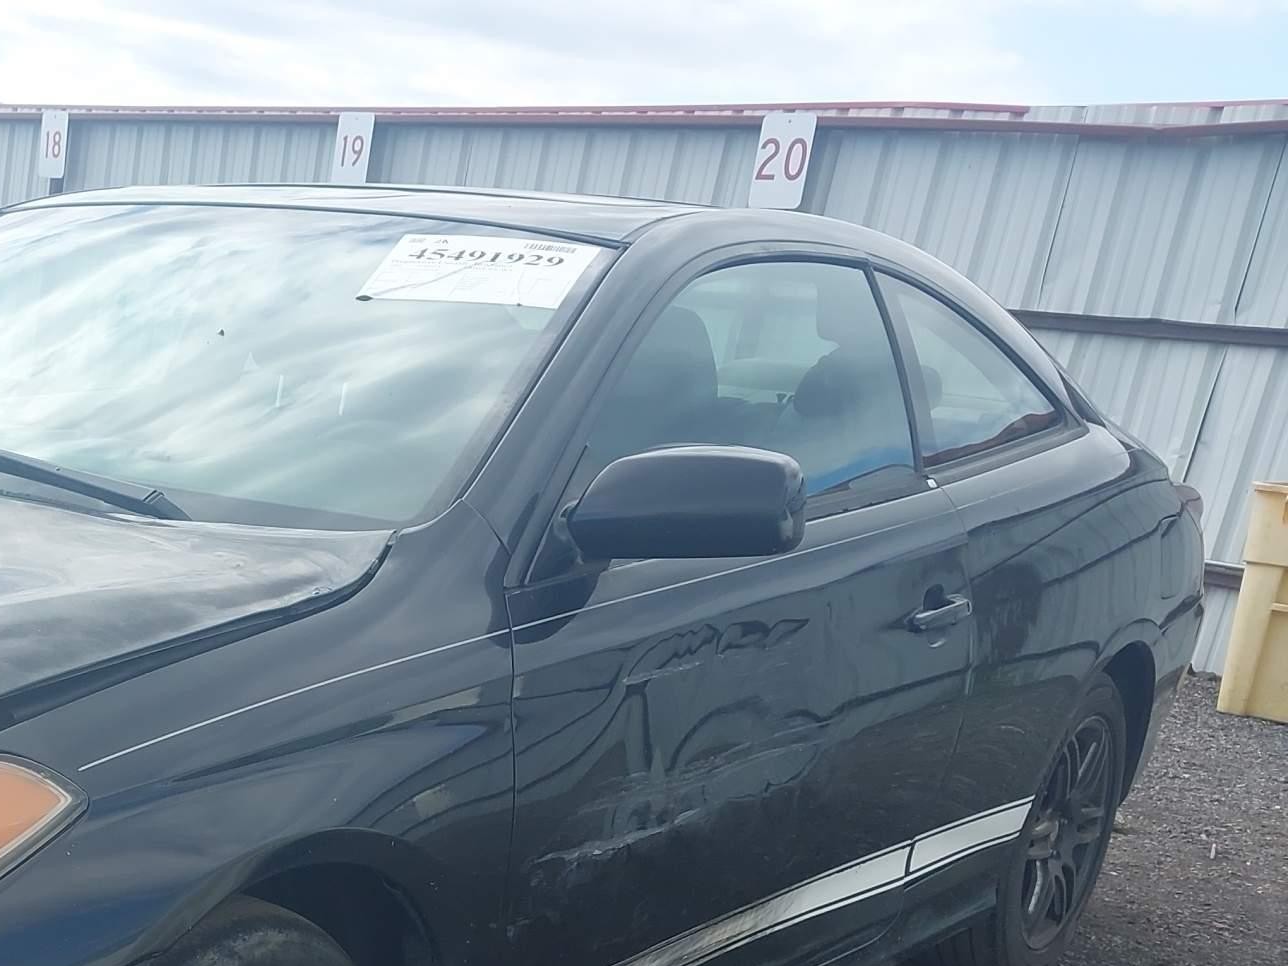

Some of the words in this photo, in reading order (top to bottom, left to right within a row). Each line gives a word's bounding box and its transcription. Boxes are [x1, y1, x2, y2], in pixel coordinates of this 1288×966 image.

[45, 131, 62, 159] 18
[341, 135, 365, 167] 19
[755, 137, 809, 182] 20
[408, 248, 565, 267] 45491929
